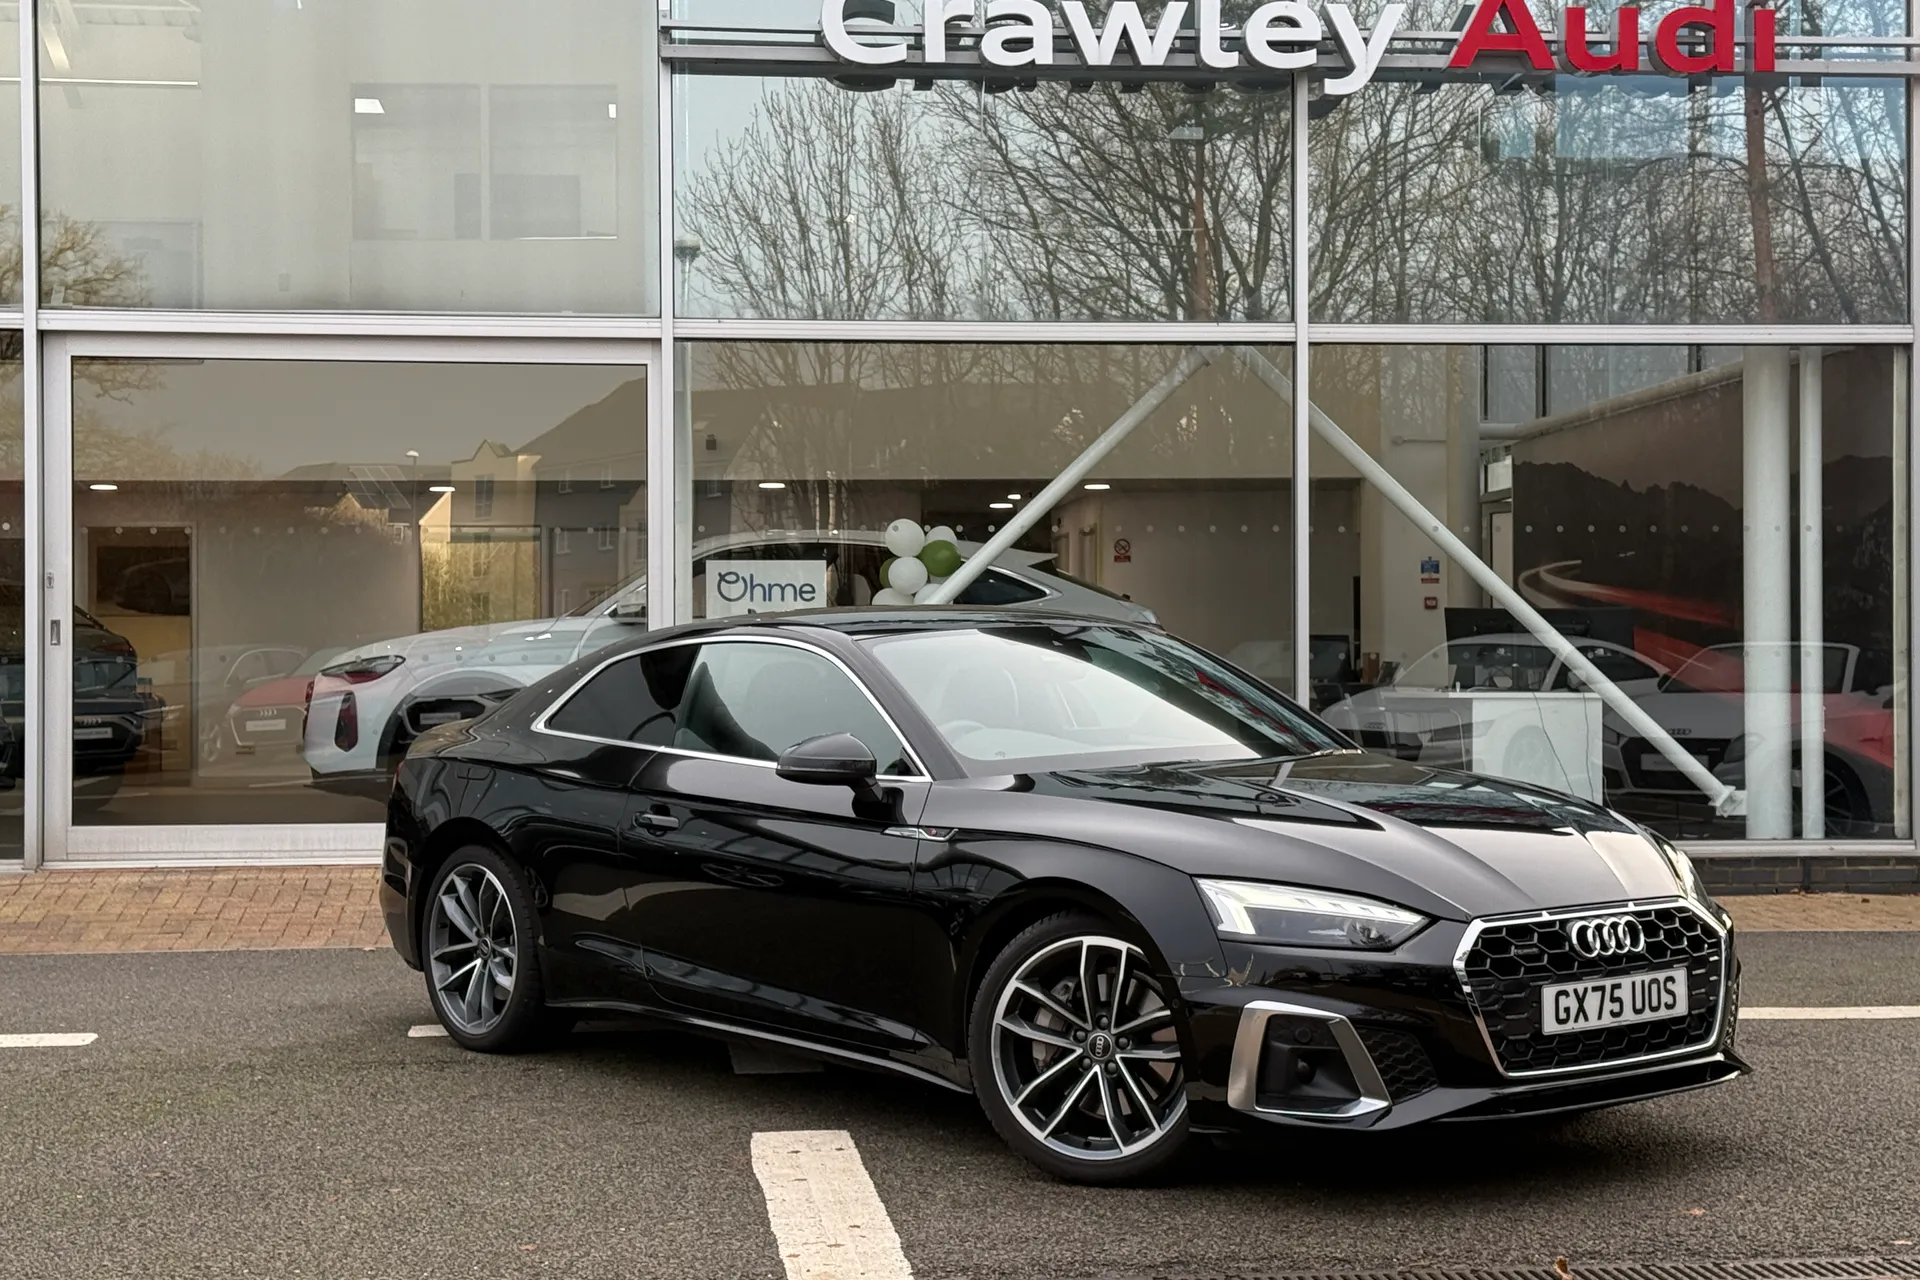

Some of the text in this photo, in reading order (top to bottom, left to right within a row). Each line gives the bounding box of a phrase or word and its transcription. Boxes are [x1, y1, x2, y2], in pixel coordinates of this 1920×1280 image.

[821, 0, 1775, 95] Crawley Audi
[717, 571, 816, 602] Ohme
[1554, 976, 1677, 1025] GX75 UOS
